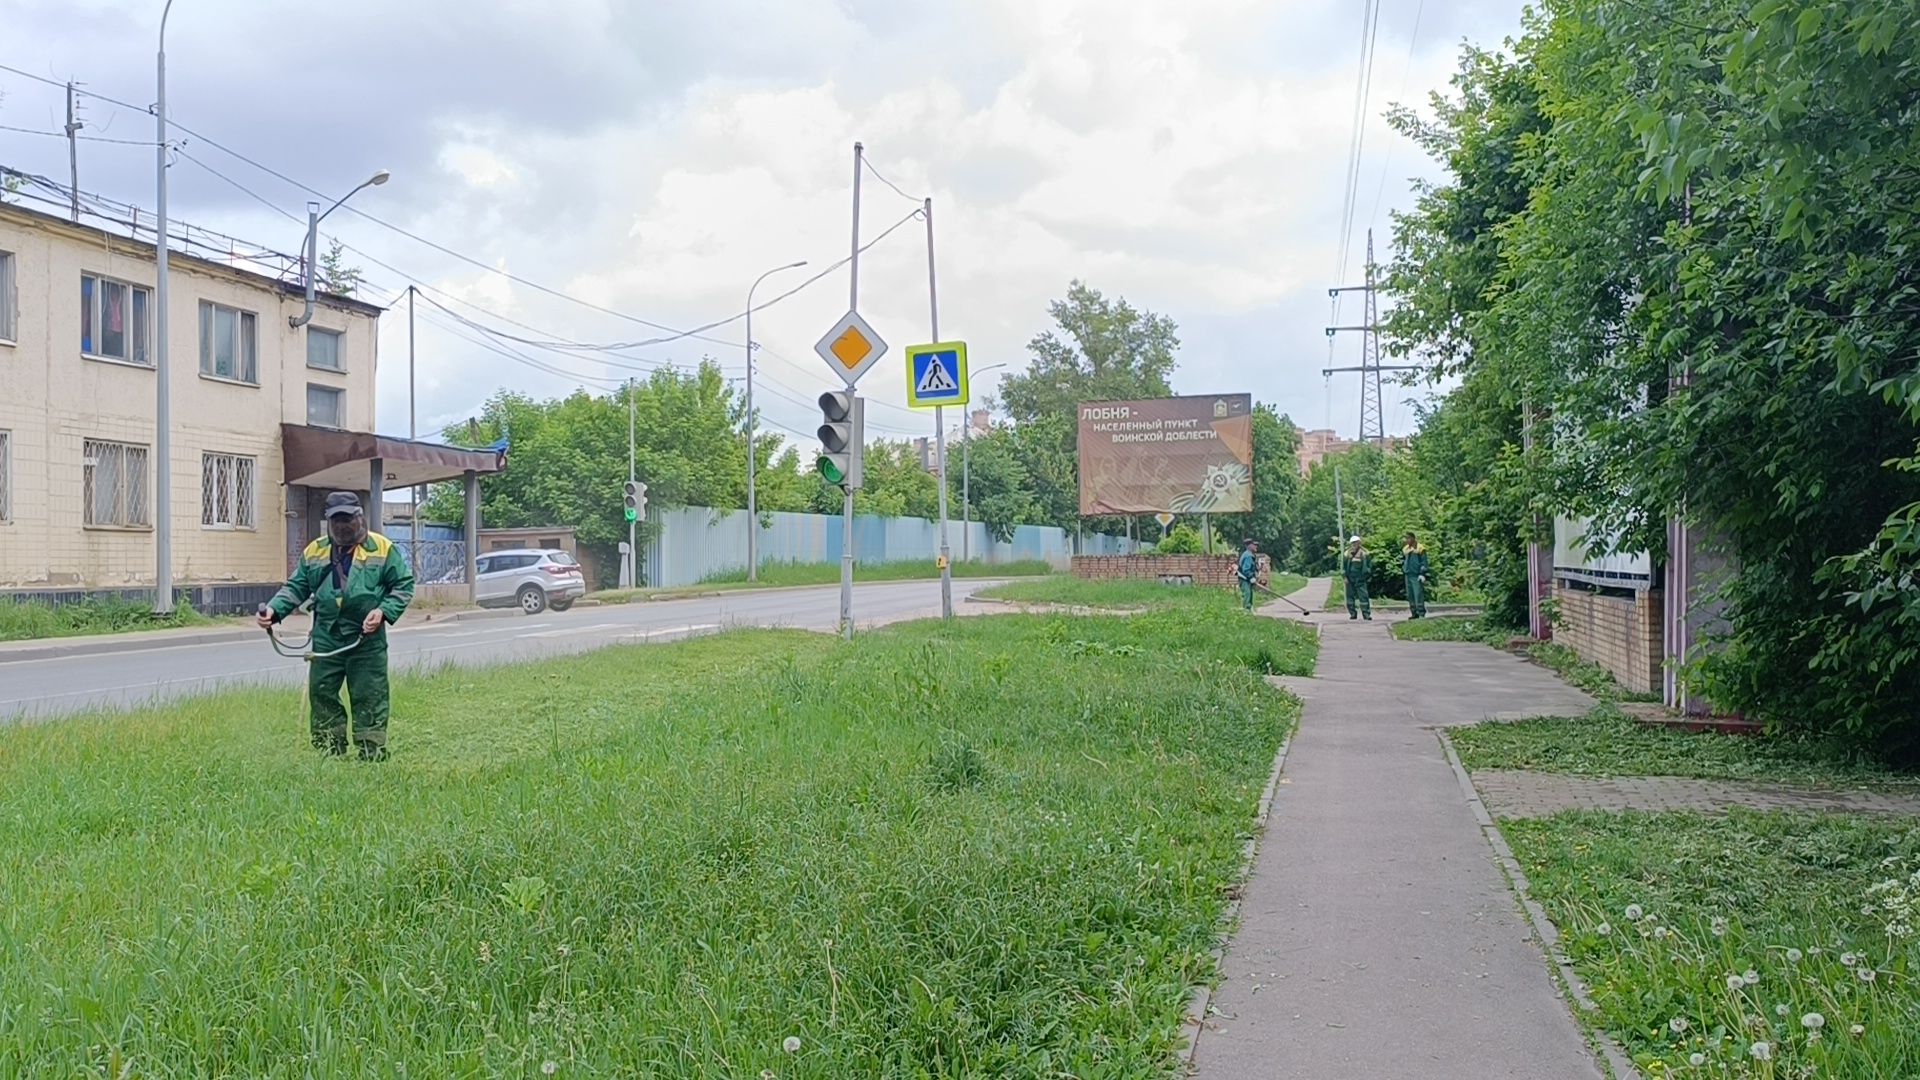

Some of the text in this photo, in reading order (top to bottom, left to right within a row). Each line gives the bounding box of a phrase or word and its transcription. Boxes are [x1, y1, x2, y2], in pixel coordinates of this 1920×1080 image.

[1081, 407, 1130, 420] ЛОБНЯ
[1093, 419, 1198, 432] НАСЕЛЕННЫЙ ПУНКТ
[1112, 430, 1217, 443] ВОИНСКОЙ ДОБЛЕСТИ
